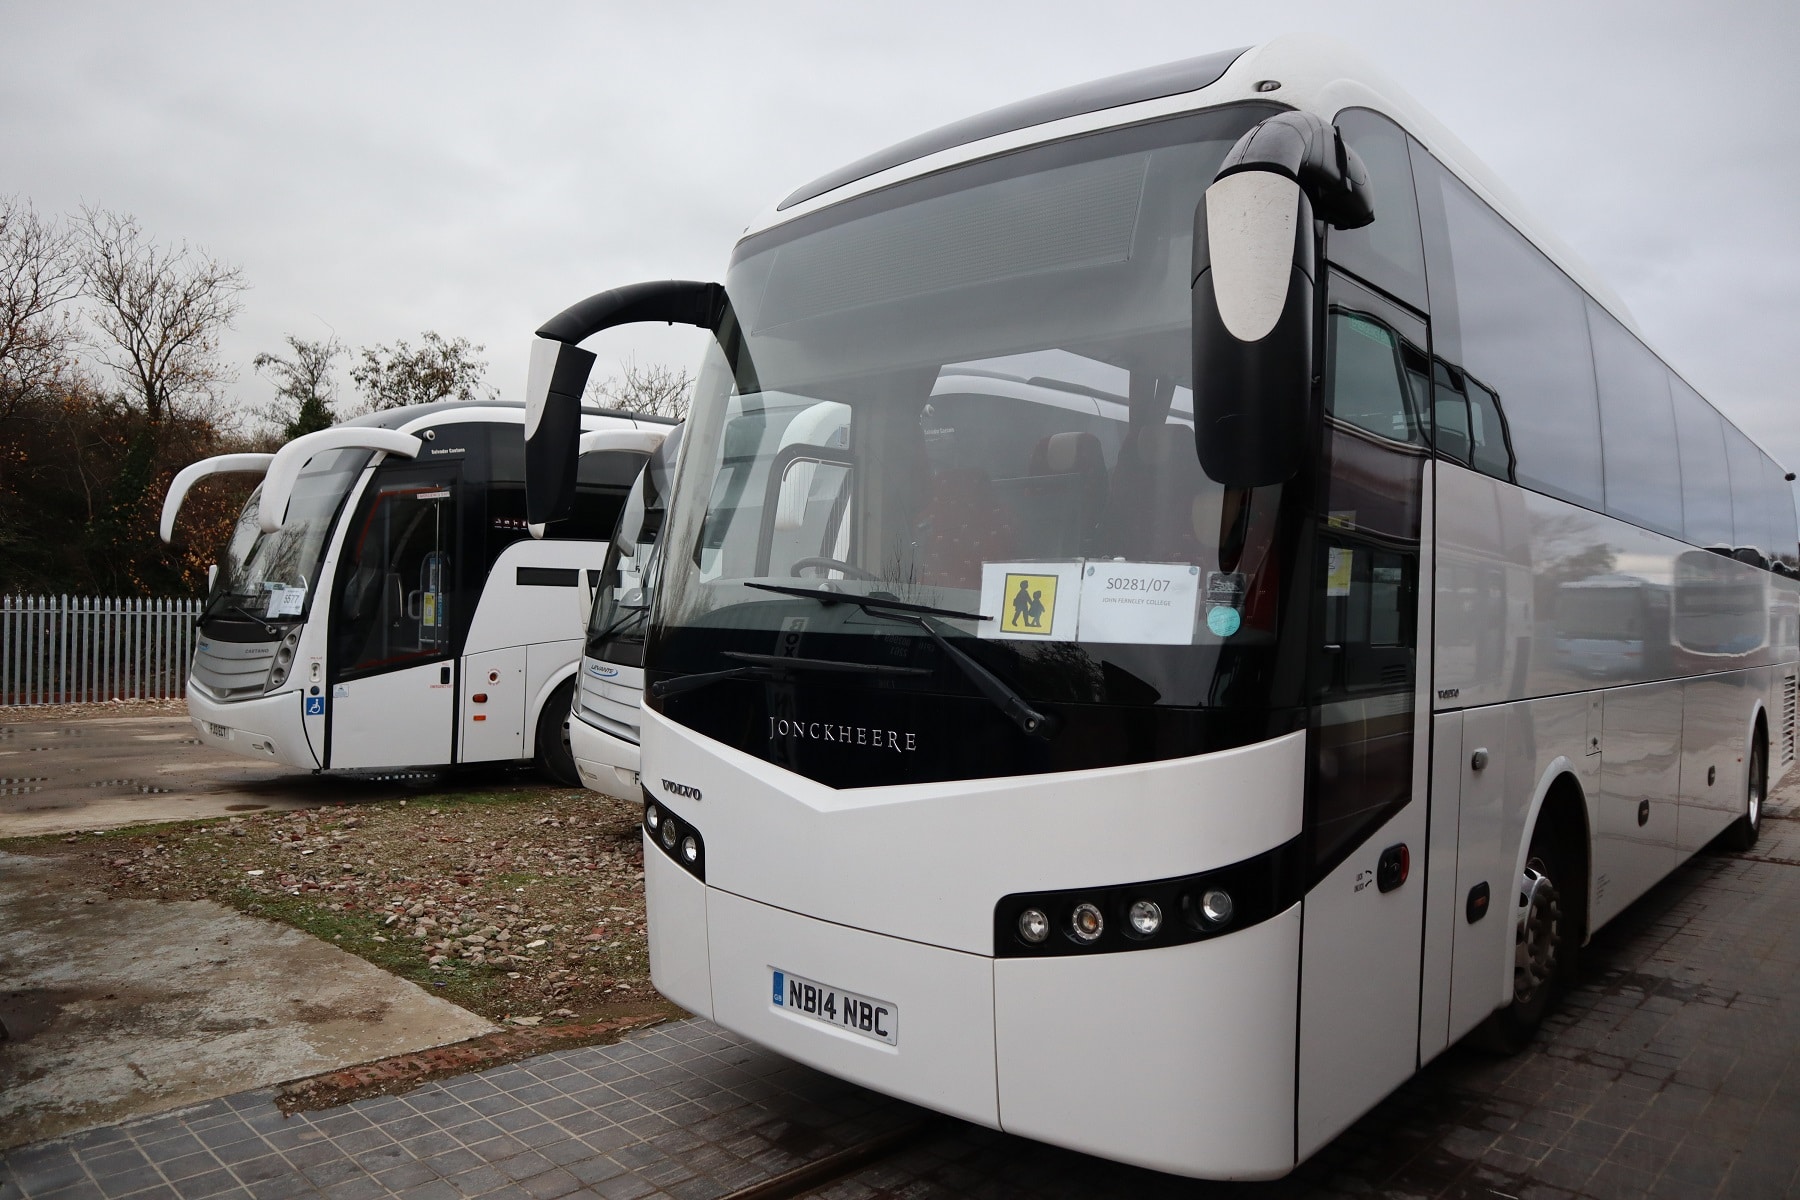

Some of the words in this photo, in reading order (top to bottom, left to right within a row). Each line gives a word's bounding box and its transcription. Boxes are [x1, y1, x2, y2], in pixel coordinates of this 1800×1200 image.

[1106, 577, 1171, 593] S0281/07
[1145, 599, 1172, 607] COLLEGE
[769, 716, 917, 753] JONCKHEERE
[661, 778, 702, 800] VOLVO
[789, 979, 837, 1020] NB14
[843, 996, 889, 1037] NBC
